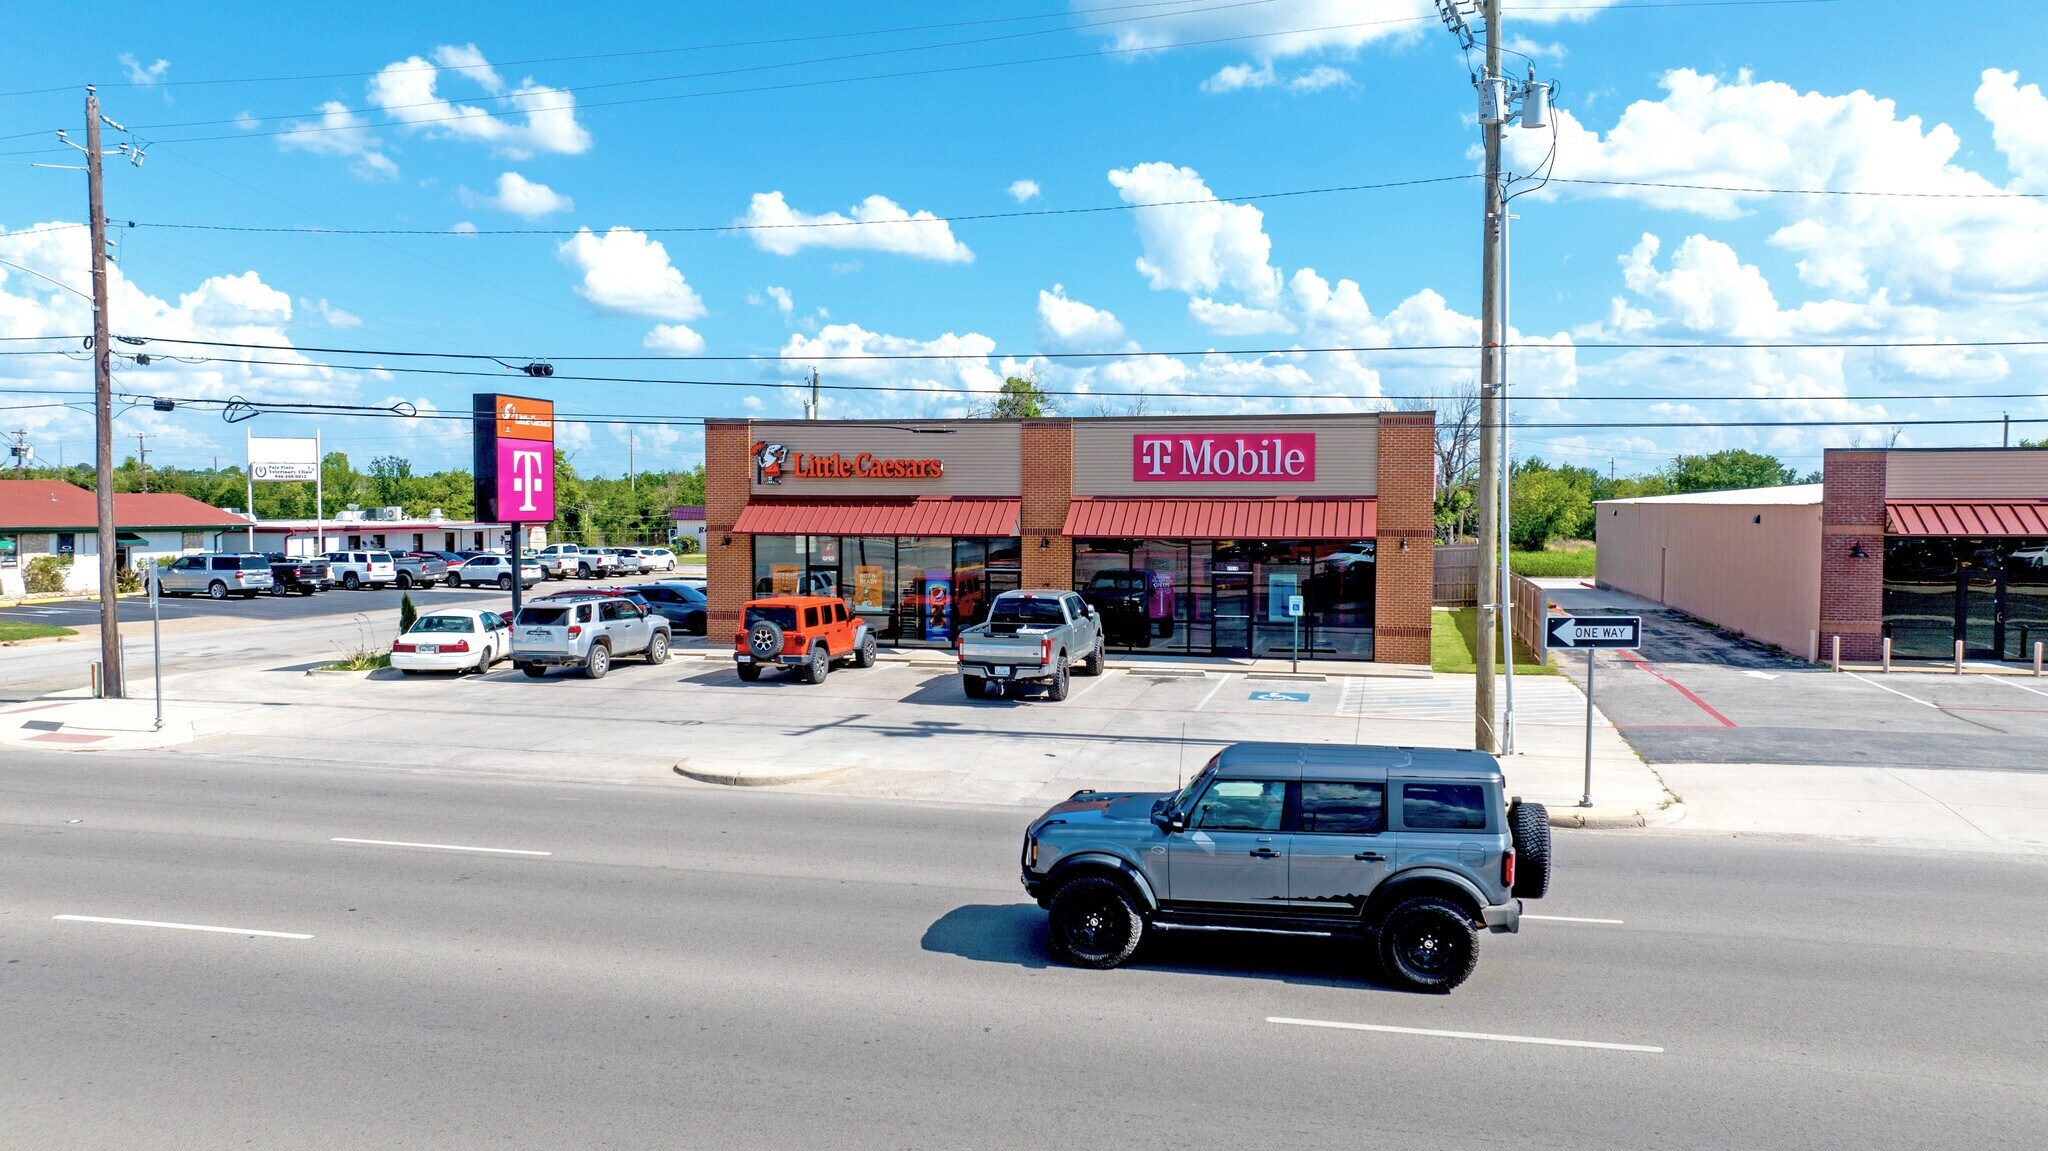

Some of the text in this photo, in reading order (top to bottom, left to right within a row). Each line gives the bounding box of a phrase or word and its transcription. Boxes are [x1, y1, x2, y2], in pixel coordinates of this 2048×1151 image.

[792, 452, 942, 478] Little Caesars
[1142, 439, 1305, 475] T Mobile
[513, 450, 543, 512] T
[1575, 627, 1626, 638] ONE WAY
